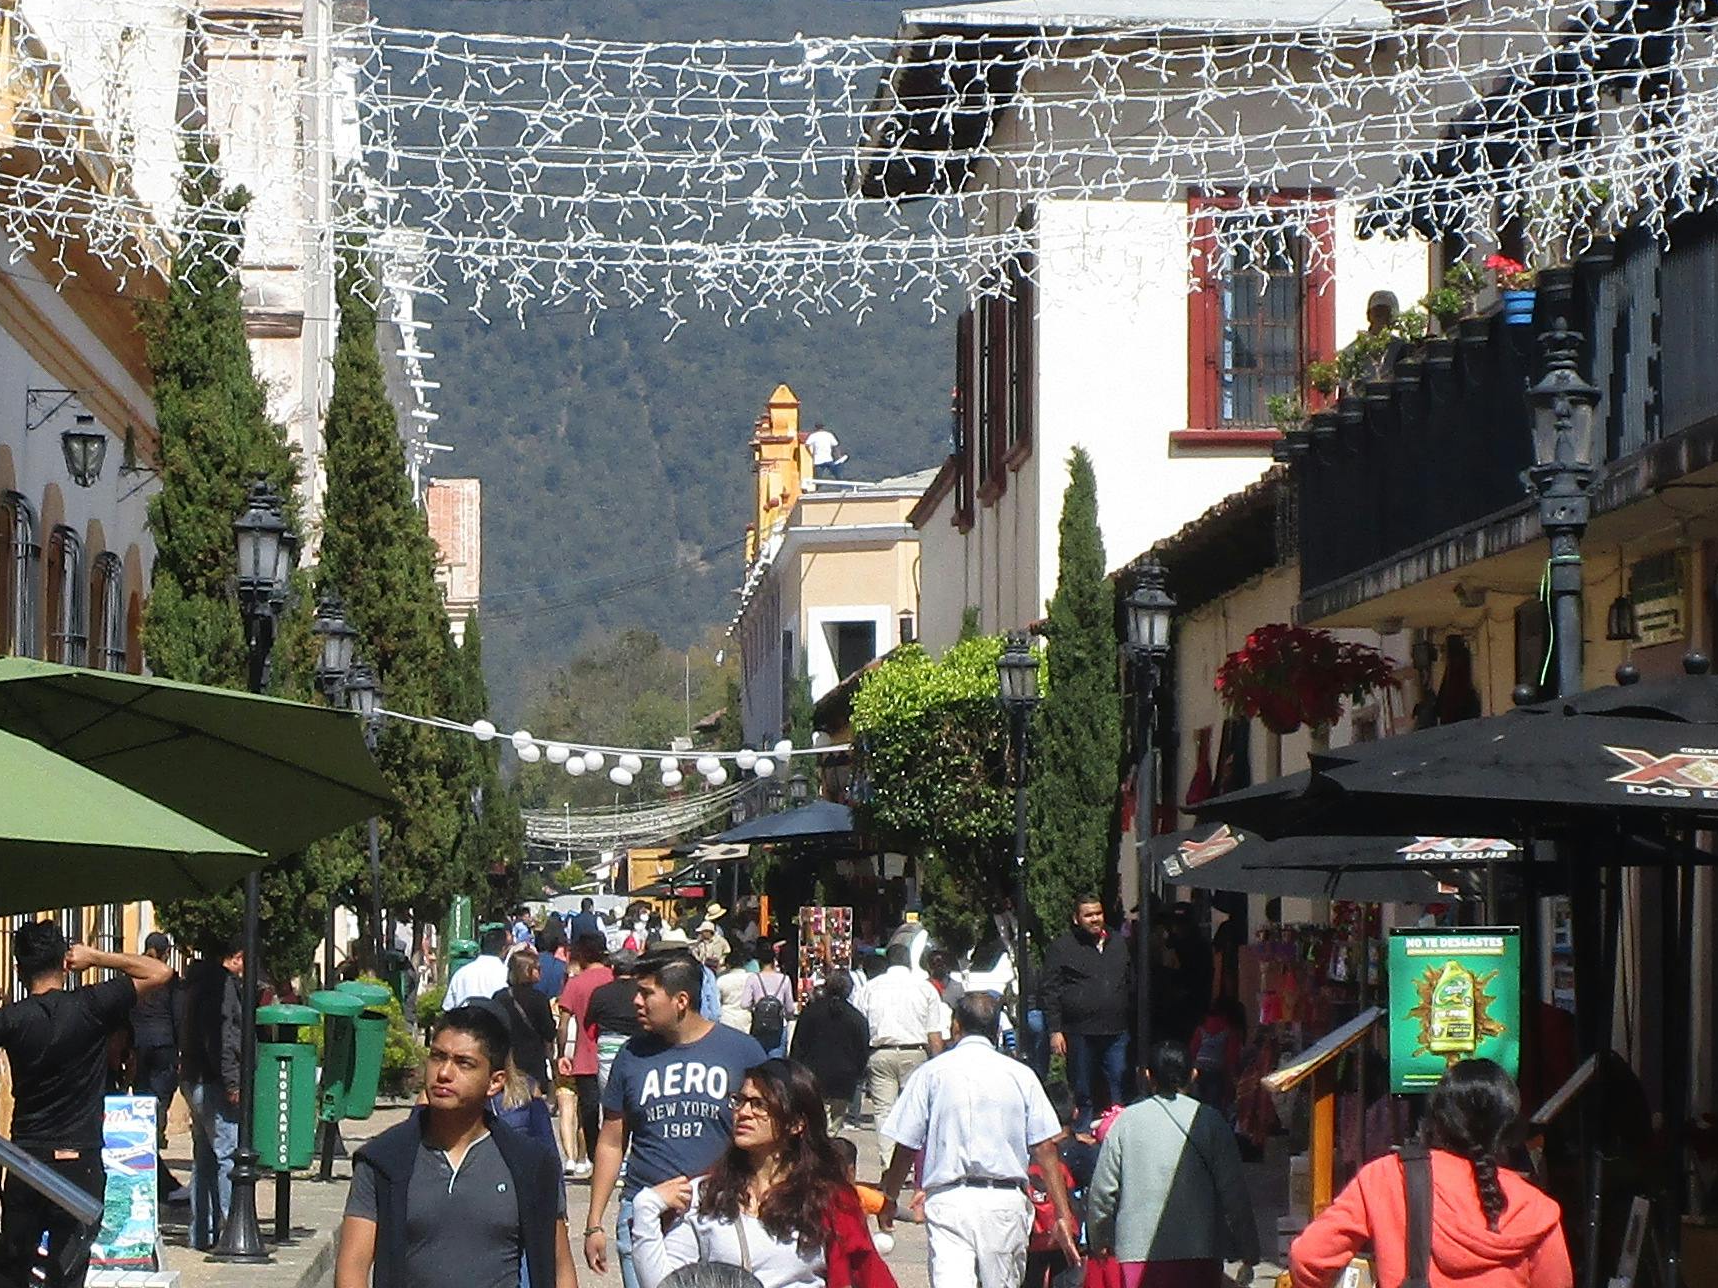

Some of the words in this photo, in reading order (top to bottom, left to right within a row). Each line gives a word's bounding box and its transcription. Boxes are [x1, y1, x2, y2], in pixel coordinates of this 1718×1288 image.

[1626, 785, 1692, 798] DOS
[1405, 850, 1451, 861] DOS
[1453, 850, 1509, 861] EQUIS
[1405, 937, 1422, 948] NO
[1424, 937, 1438, 948] TE
[1439, 937, 1504, 948] DESGASTES
[639, 1062, 728, 1106] AERO
[646, 1101, 677, 1122] NEW
[680, 1101, 721, 1121] YORK
[662, 1121, 704, 1139] 1987
